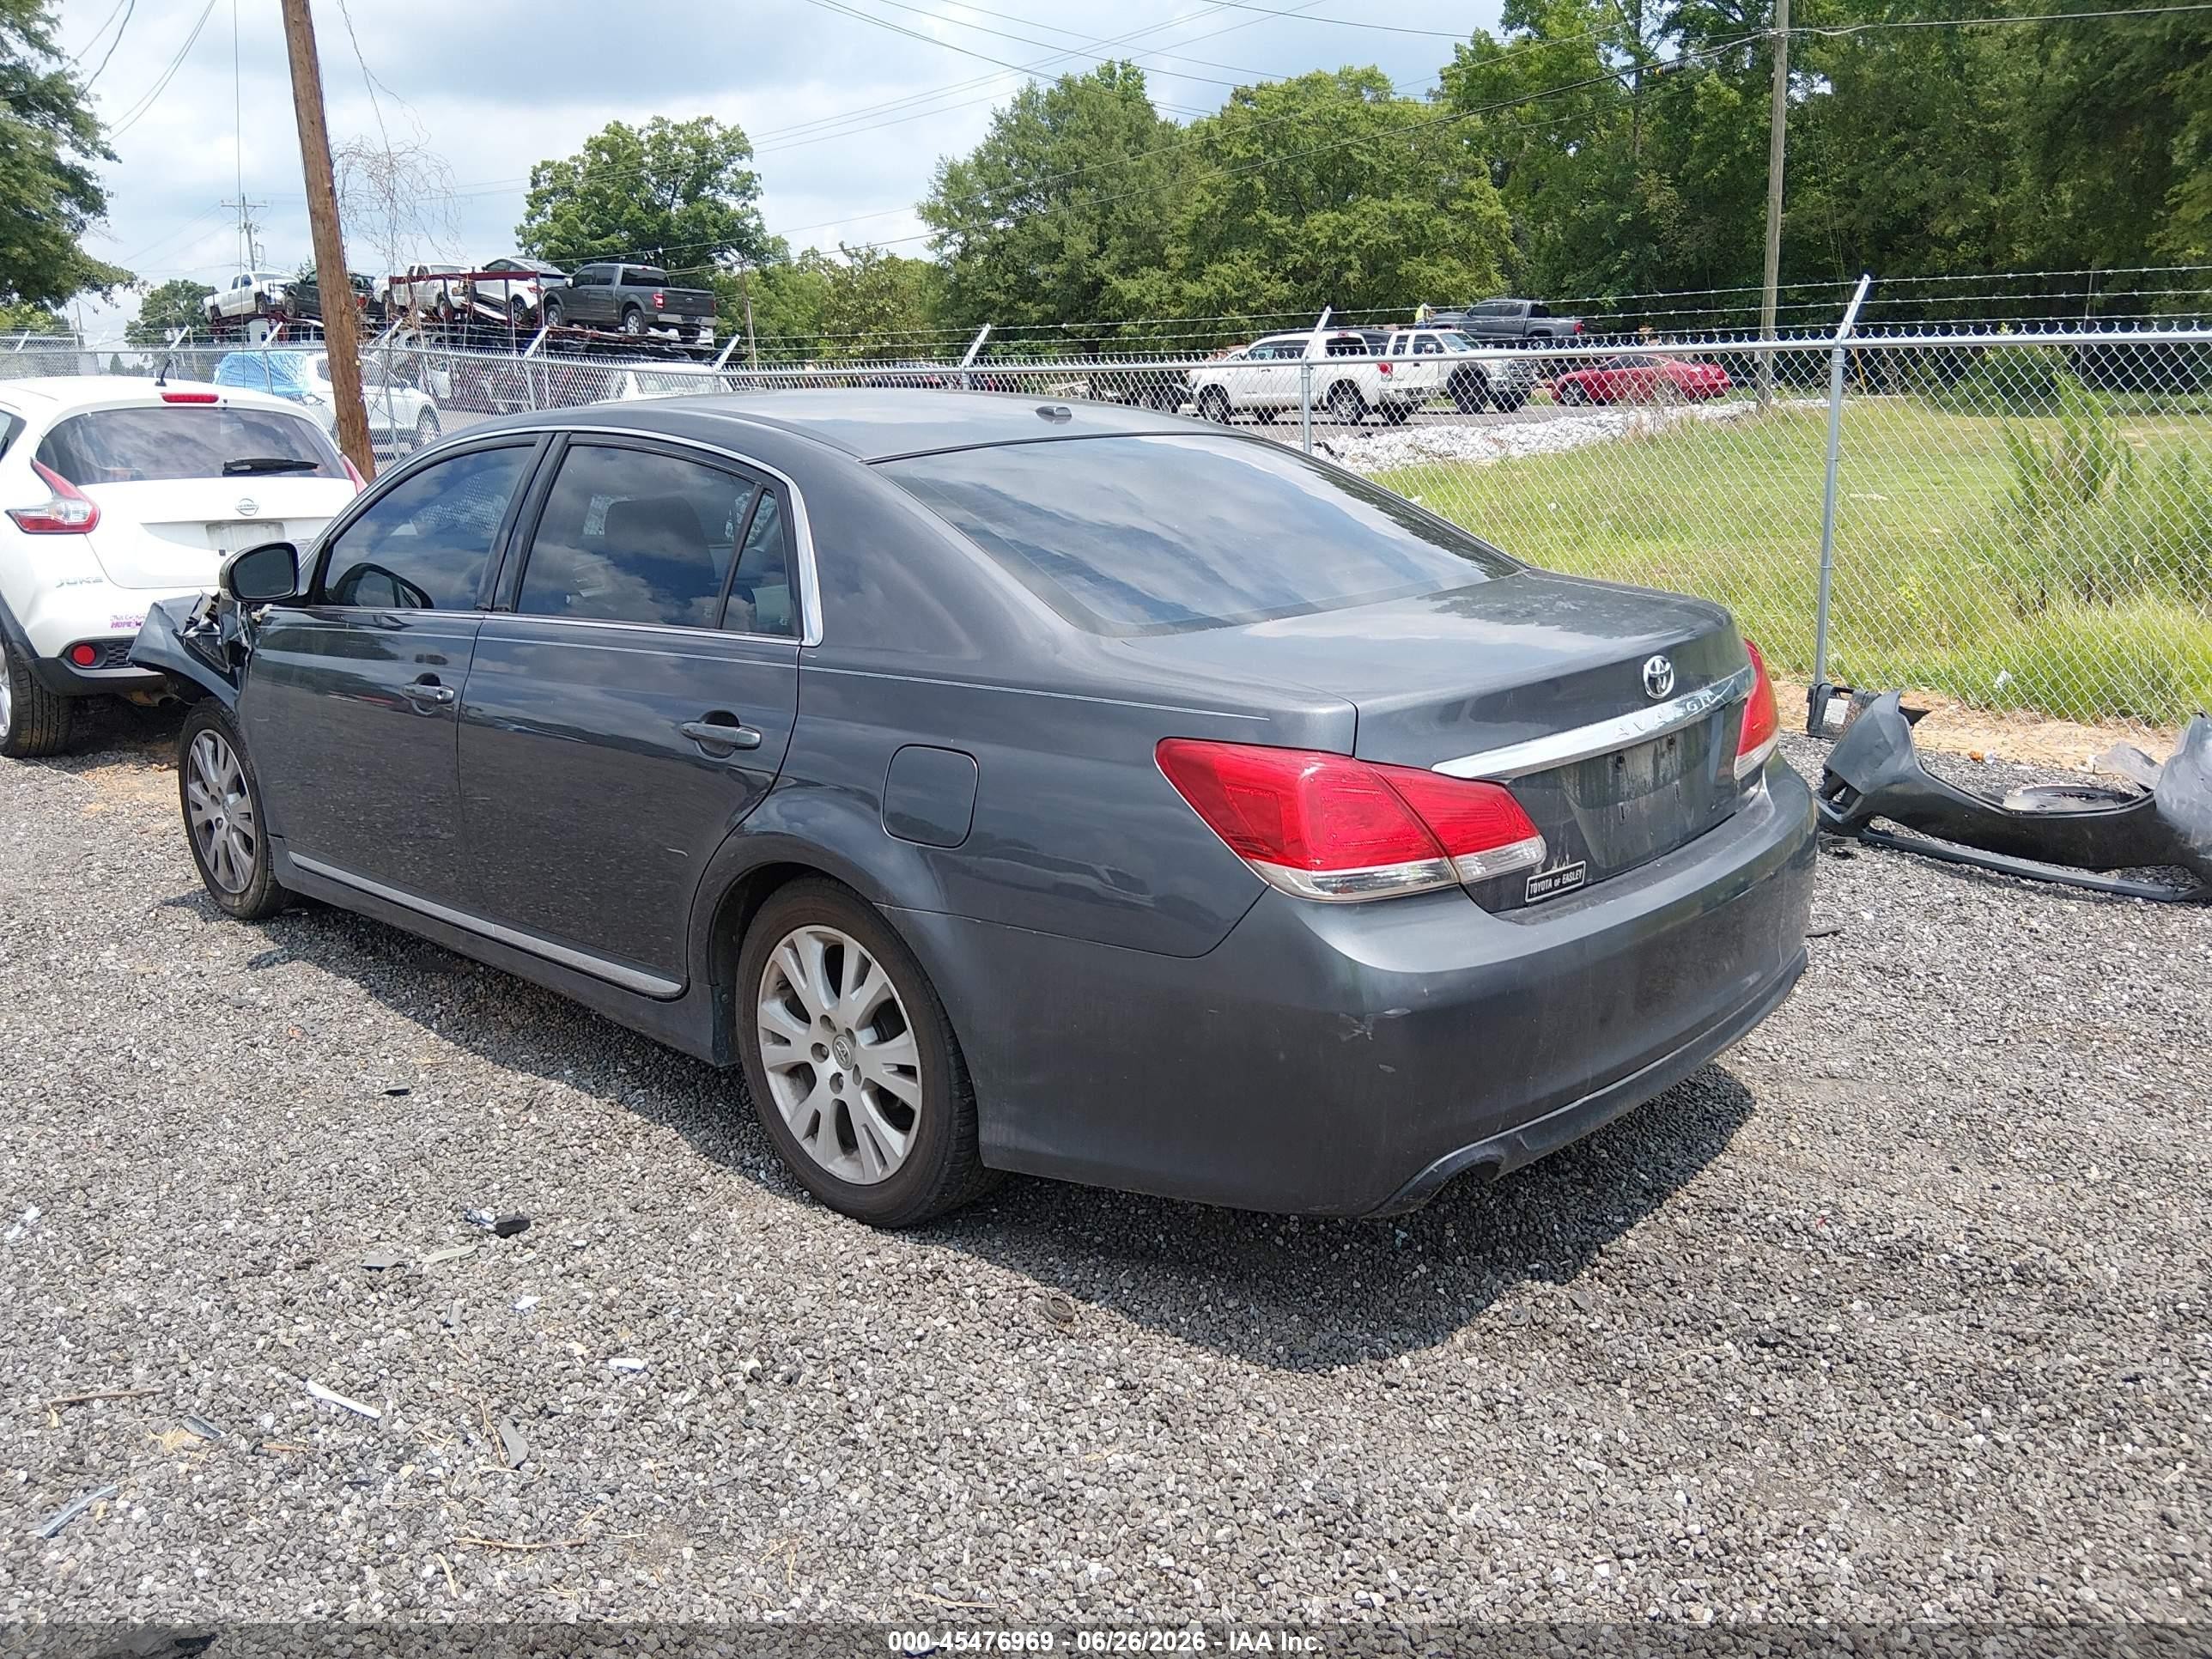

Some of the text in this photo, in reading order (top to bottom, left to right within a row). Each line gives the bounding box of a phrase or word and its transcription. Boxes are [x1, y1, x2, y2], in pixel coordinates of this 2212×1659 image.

[55, 576, 104, 589] JUKE
[1529, 878, 1553, 895] TOYOTA
[1562, 868, 1583, 884] EASLEY
